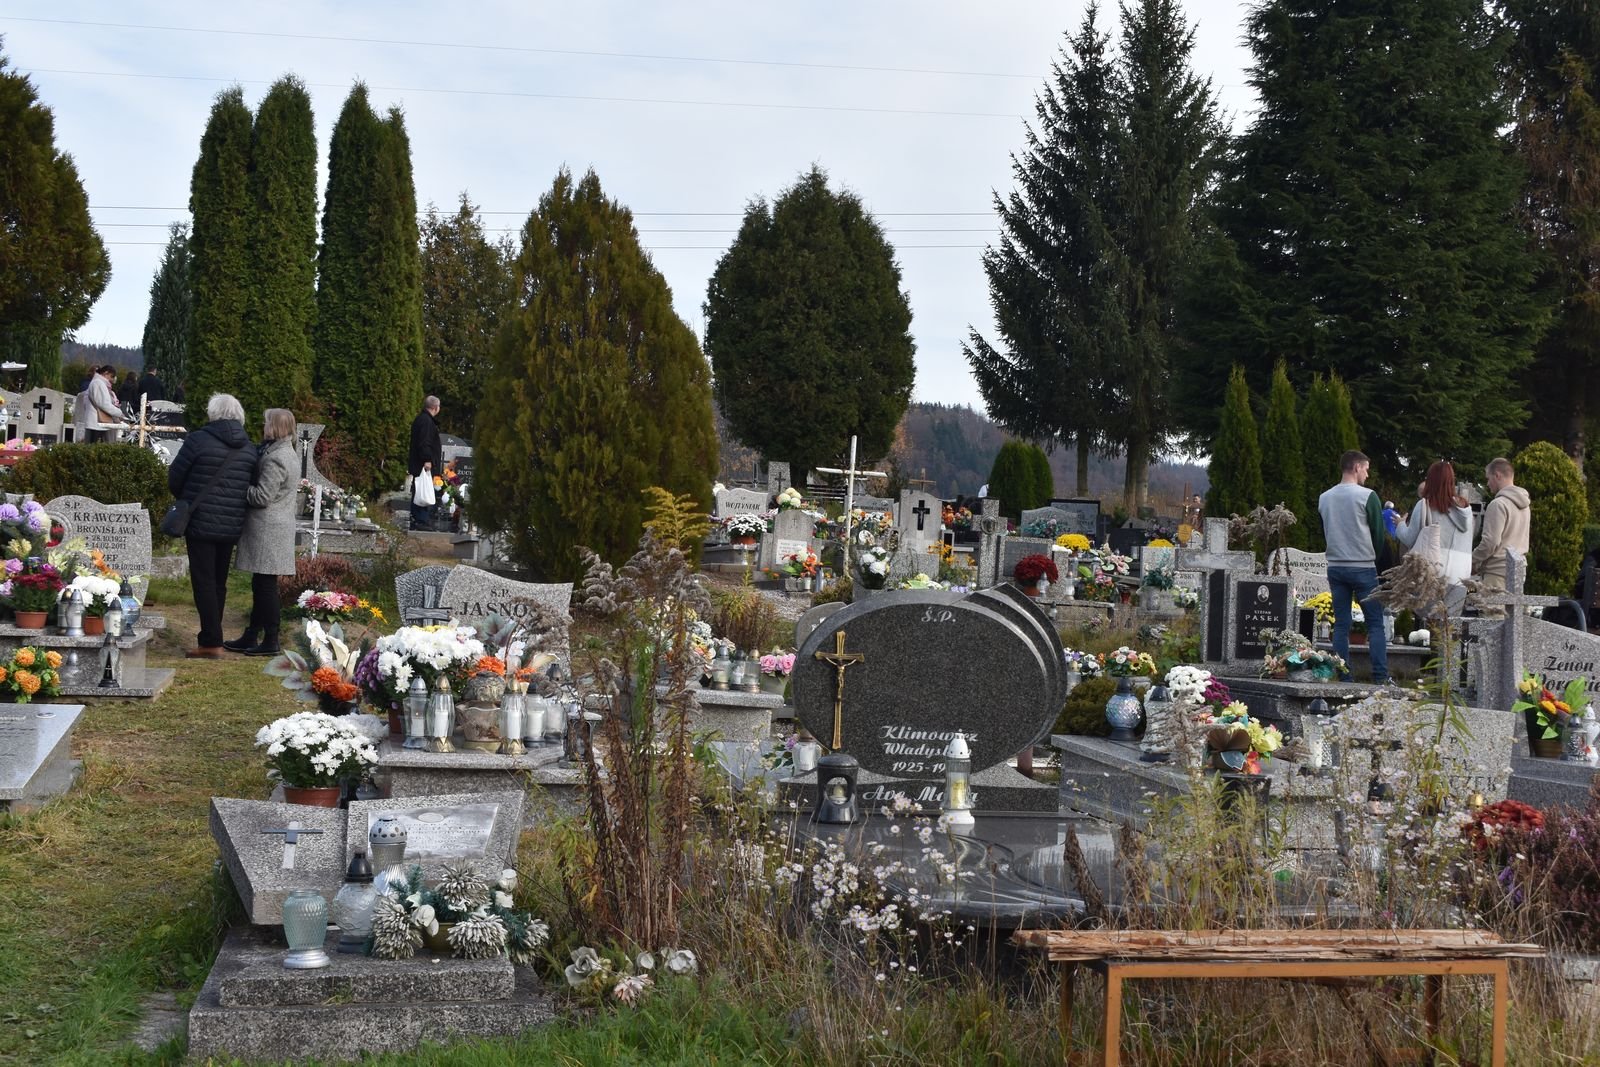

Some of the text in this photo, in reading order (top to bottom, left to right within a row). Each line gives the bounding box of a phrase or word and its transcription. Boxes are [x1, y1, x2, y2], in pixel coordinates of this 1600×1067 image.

[73, 512, 141, 524] KRAWCZYK
[921, 606, 956, 622] Ś.P.
[1245, 614, 1279, 622] PASEK
[1543, 655, 1594, 672] Zenon
